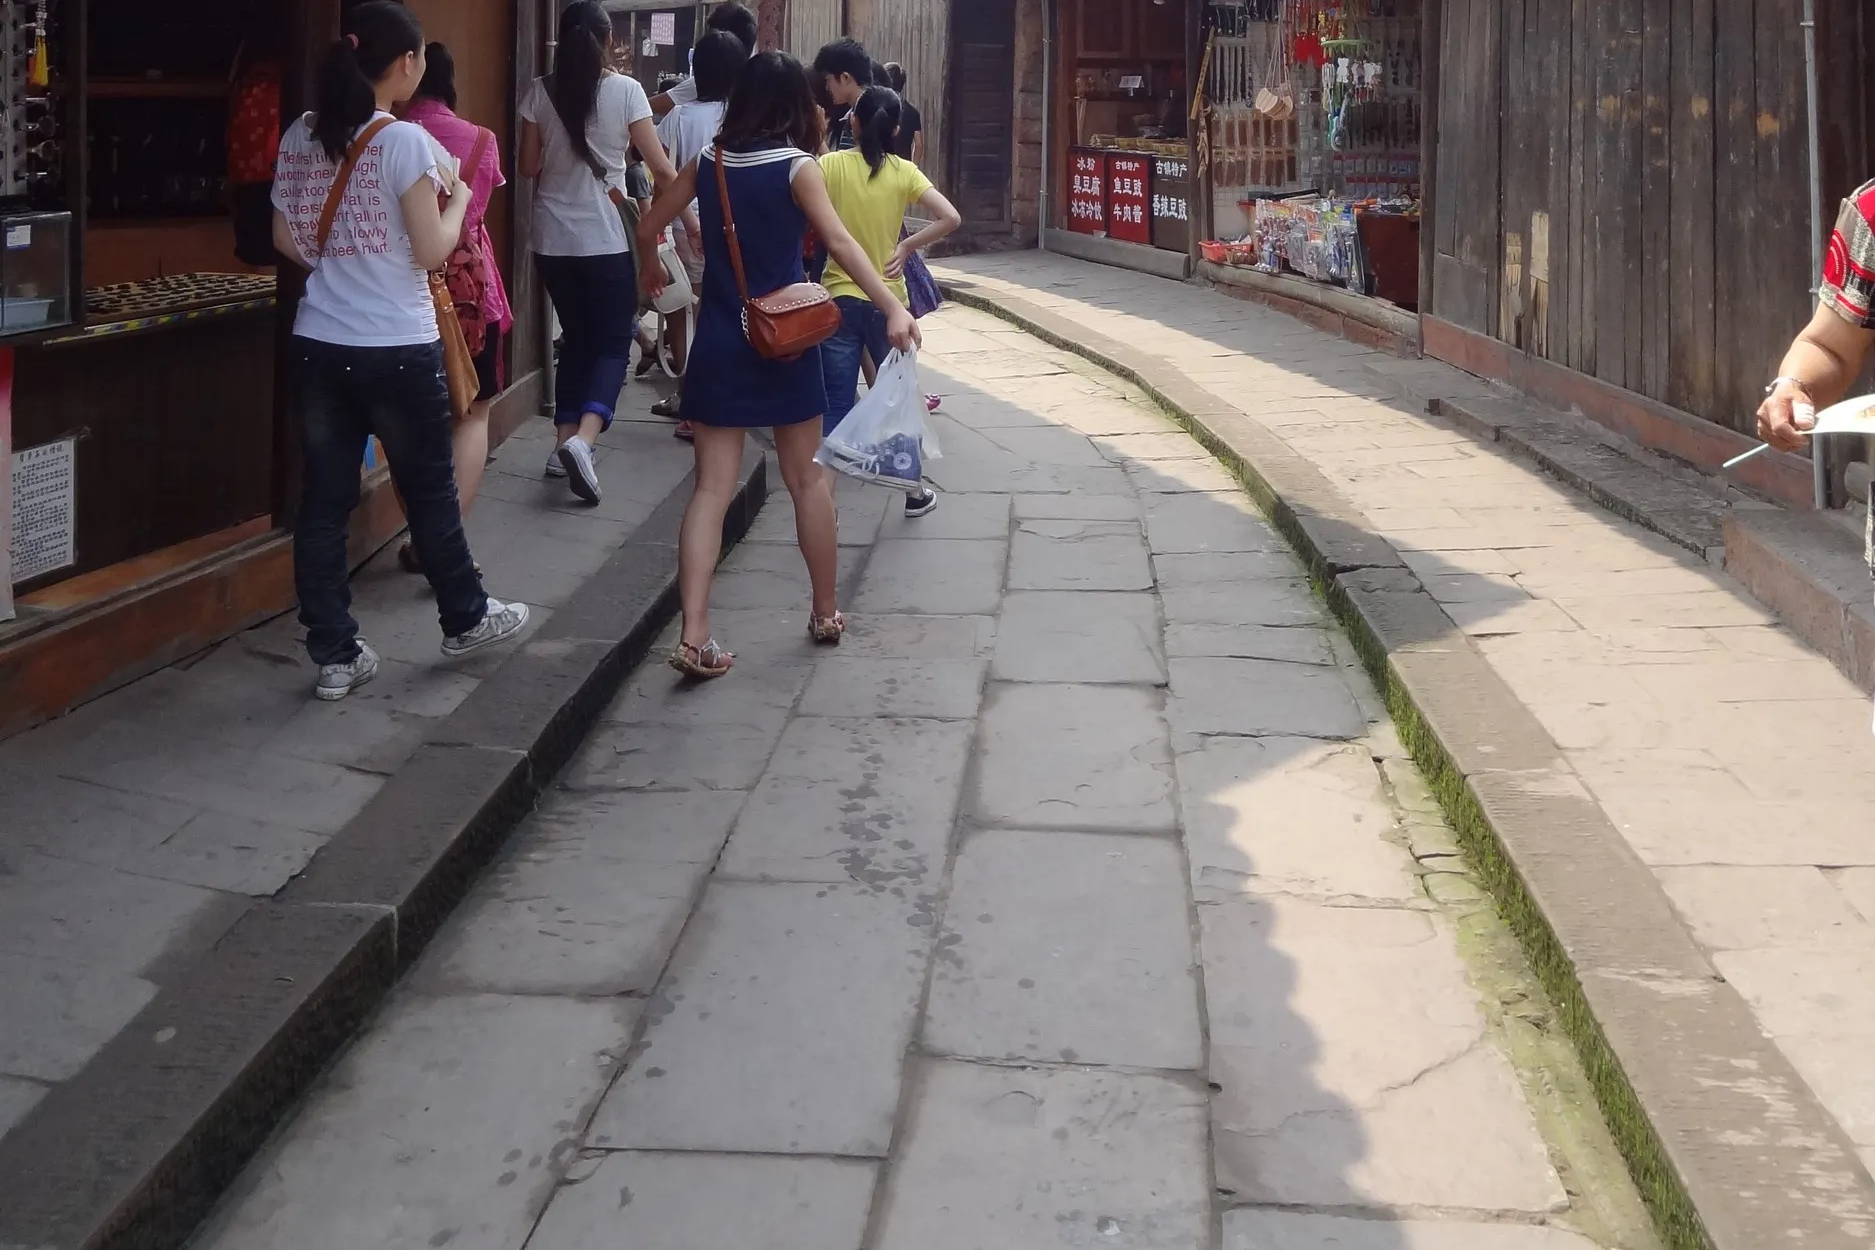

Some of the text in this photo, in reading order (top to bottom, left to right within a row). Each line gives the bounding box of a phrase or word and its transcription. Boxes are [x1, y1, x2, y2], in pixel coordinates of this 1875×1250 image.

[1077, 156, 1095, 171] 冰粉
[1115, 160, 1139, 171] 古镇特产
[1156, 160, 1187, 177] 古镇特产
[355, 177, 380, 189] lost
[1073, 174, 1100, 196] 臭豆腐
[1113, 176, 1142, 197] 鱼豆豉
[368, 194, 381, 206] is
[1152, 194, 1187, 221] 香辣豆豉
[355, 210, 371, 222] all
[374, 210, 387, 222] in
[1071, 198, 1102, 221] 冰冻冷饮
[1113, 203, 1142, 223] 牛肉酱
[362, 243, 392, 255] hurt.
